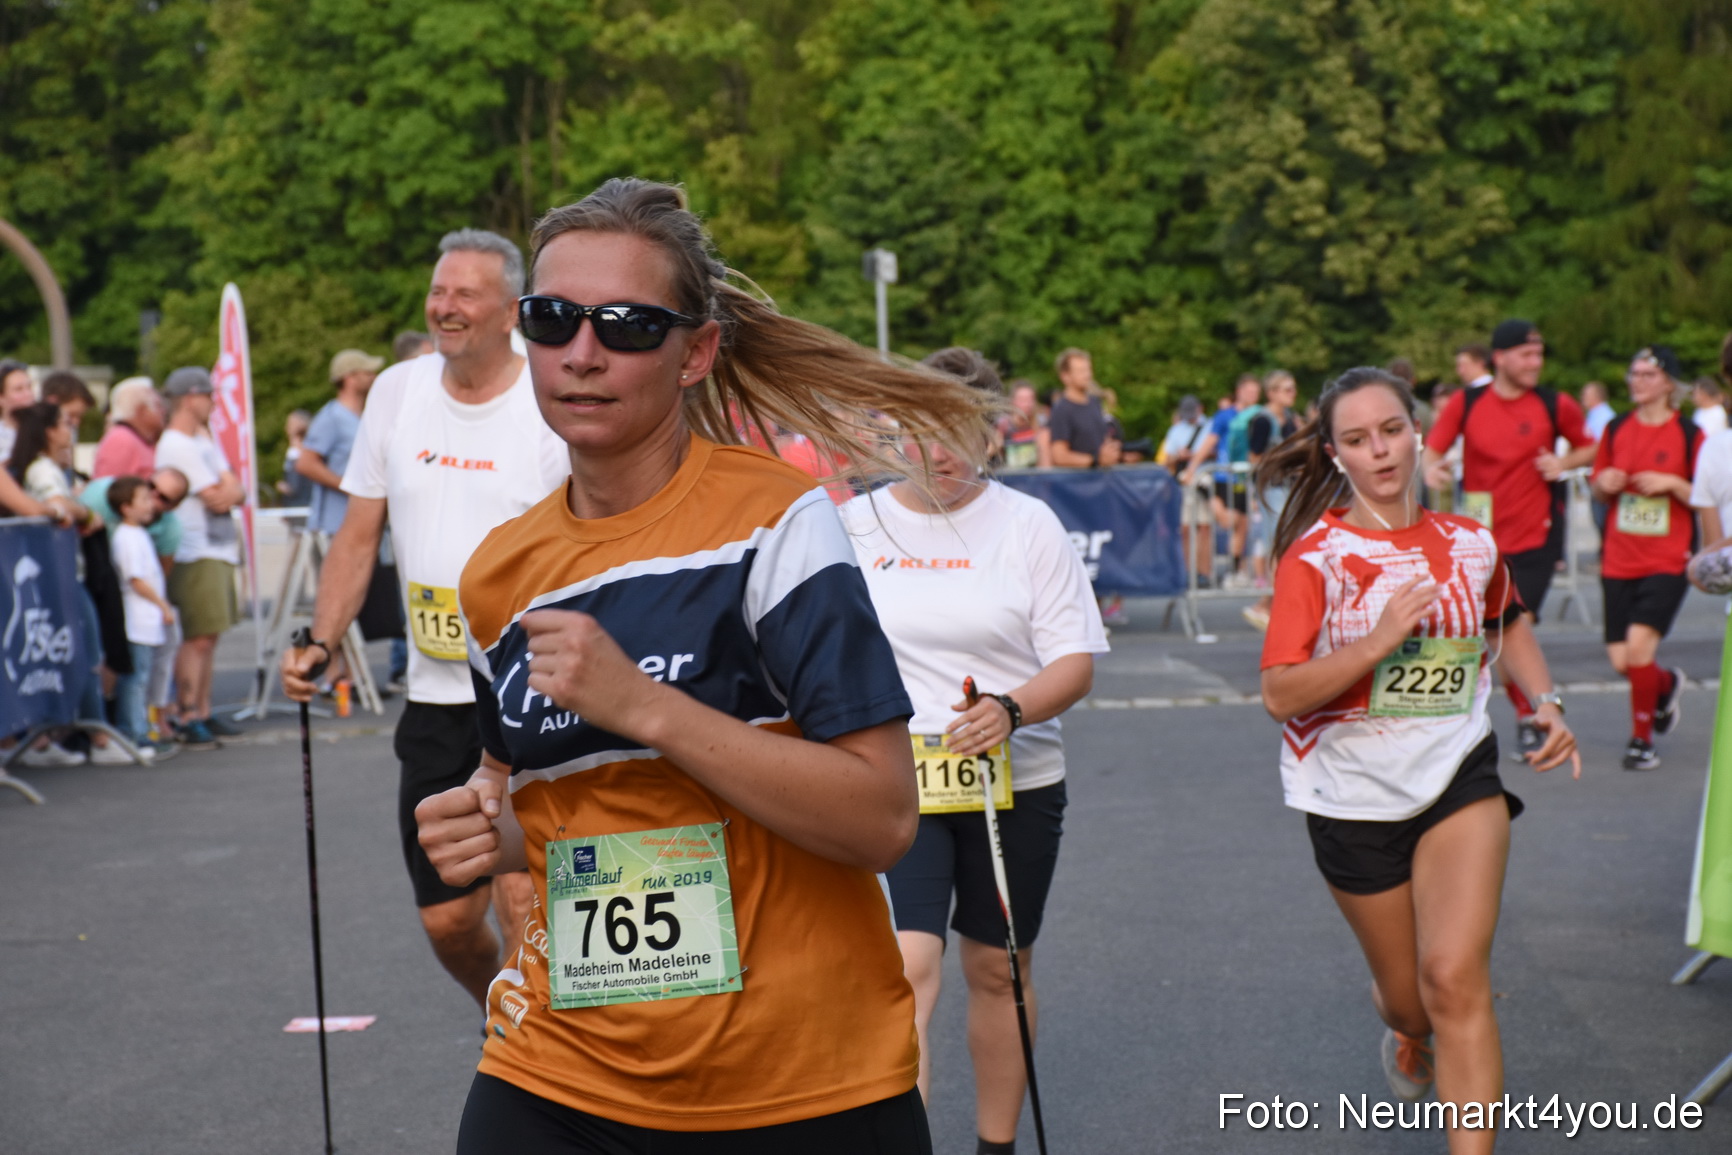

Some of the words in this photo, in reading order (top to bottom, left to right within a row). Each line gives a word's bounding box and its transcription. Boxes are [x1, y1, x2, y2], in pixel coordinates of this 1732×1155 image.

[899, 557, 976, 569] KLEBL
[417, 609, 461, 639] 115
[1385, 665, 1465, 694] 2229
[673, 870, 712, 887] 2019
[574, 891, 681, 958] 765
[564, 960, 624, 978] Madeheim
[628, 952, 711, 972] Madeleine
[572, 980, 601, 990] Fischer
[603, 974, 660, 989] Automobile
[663, 969, 699, 982] GmbH
